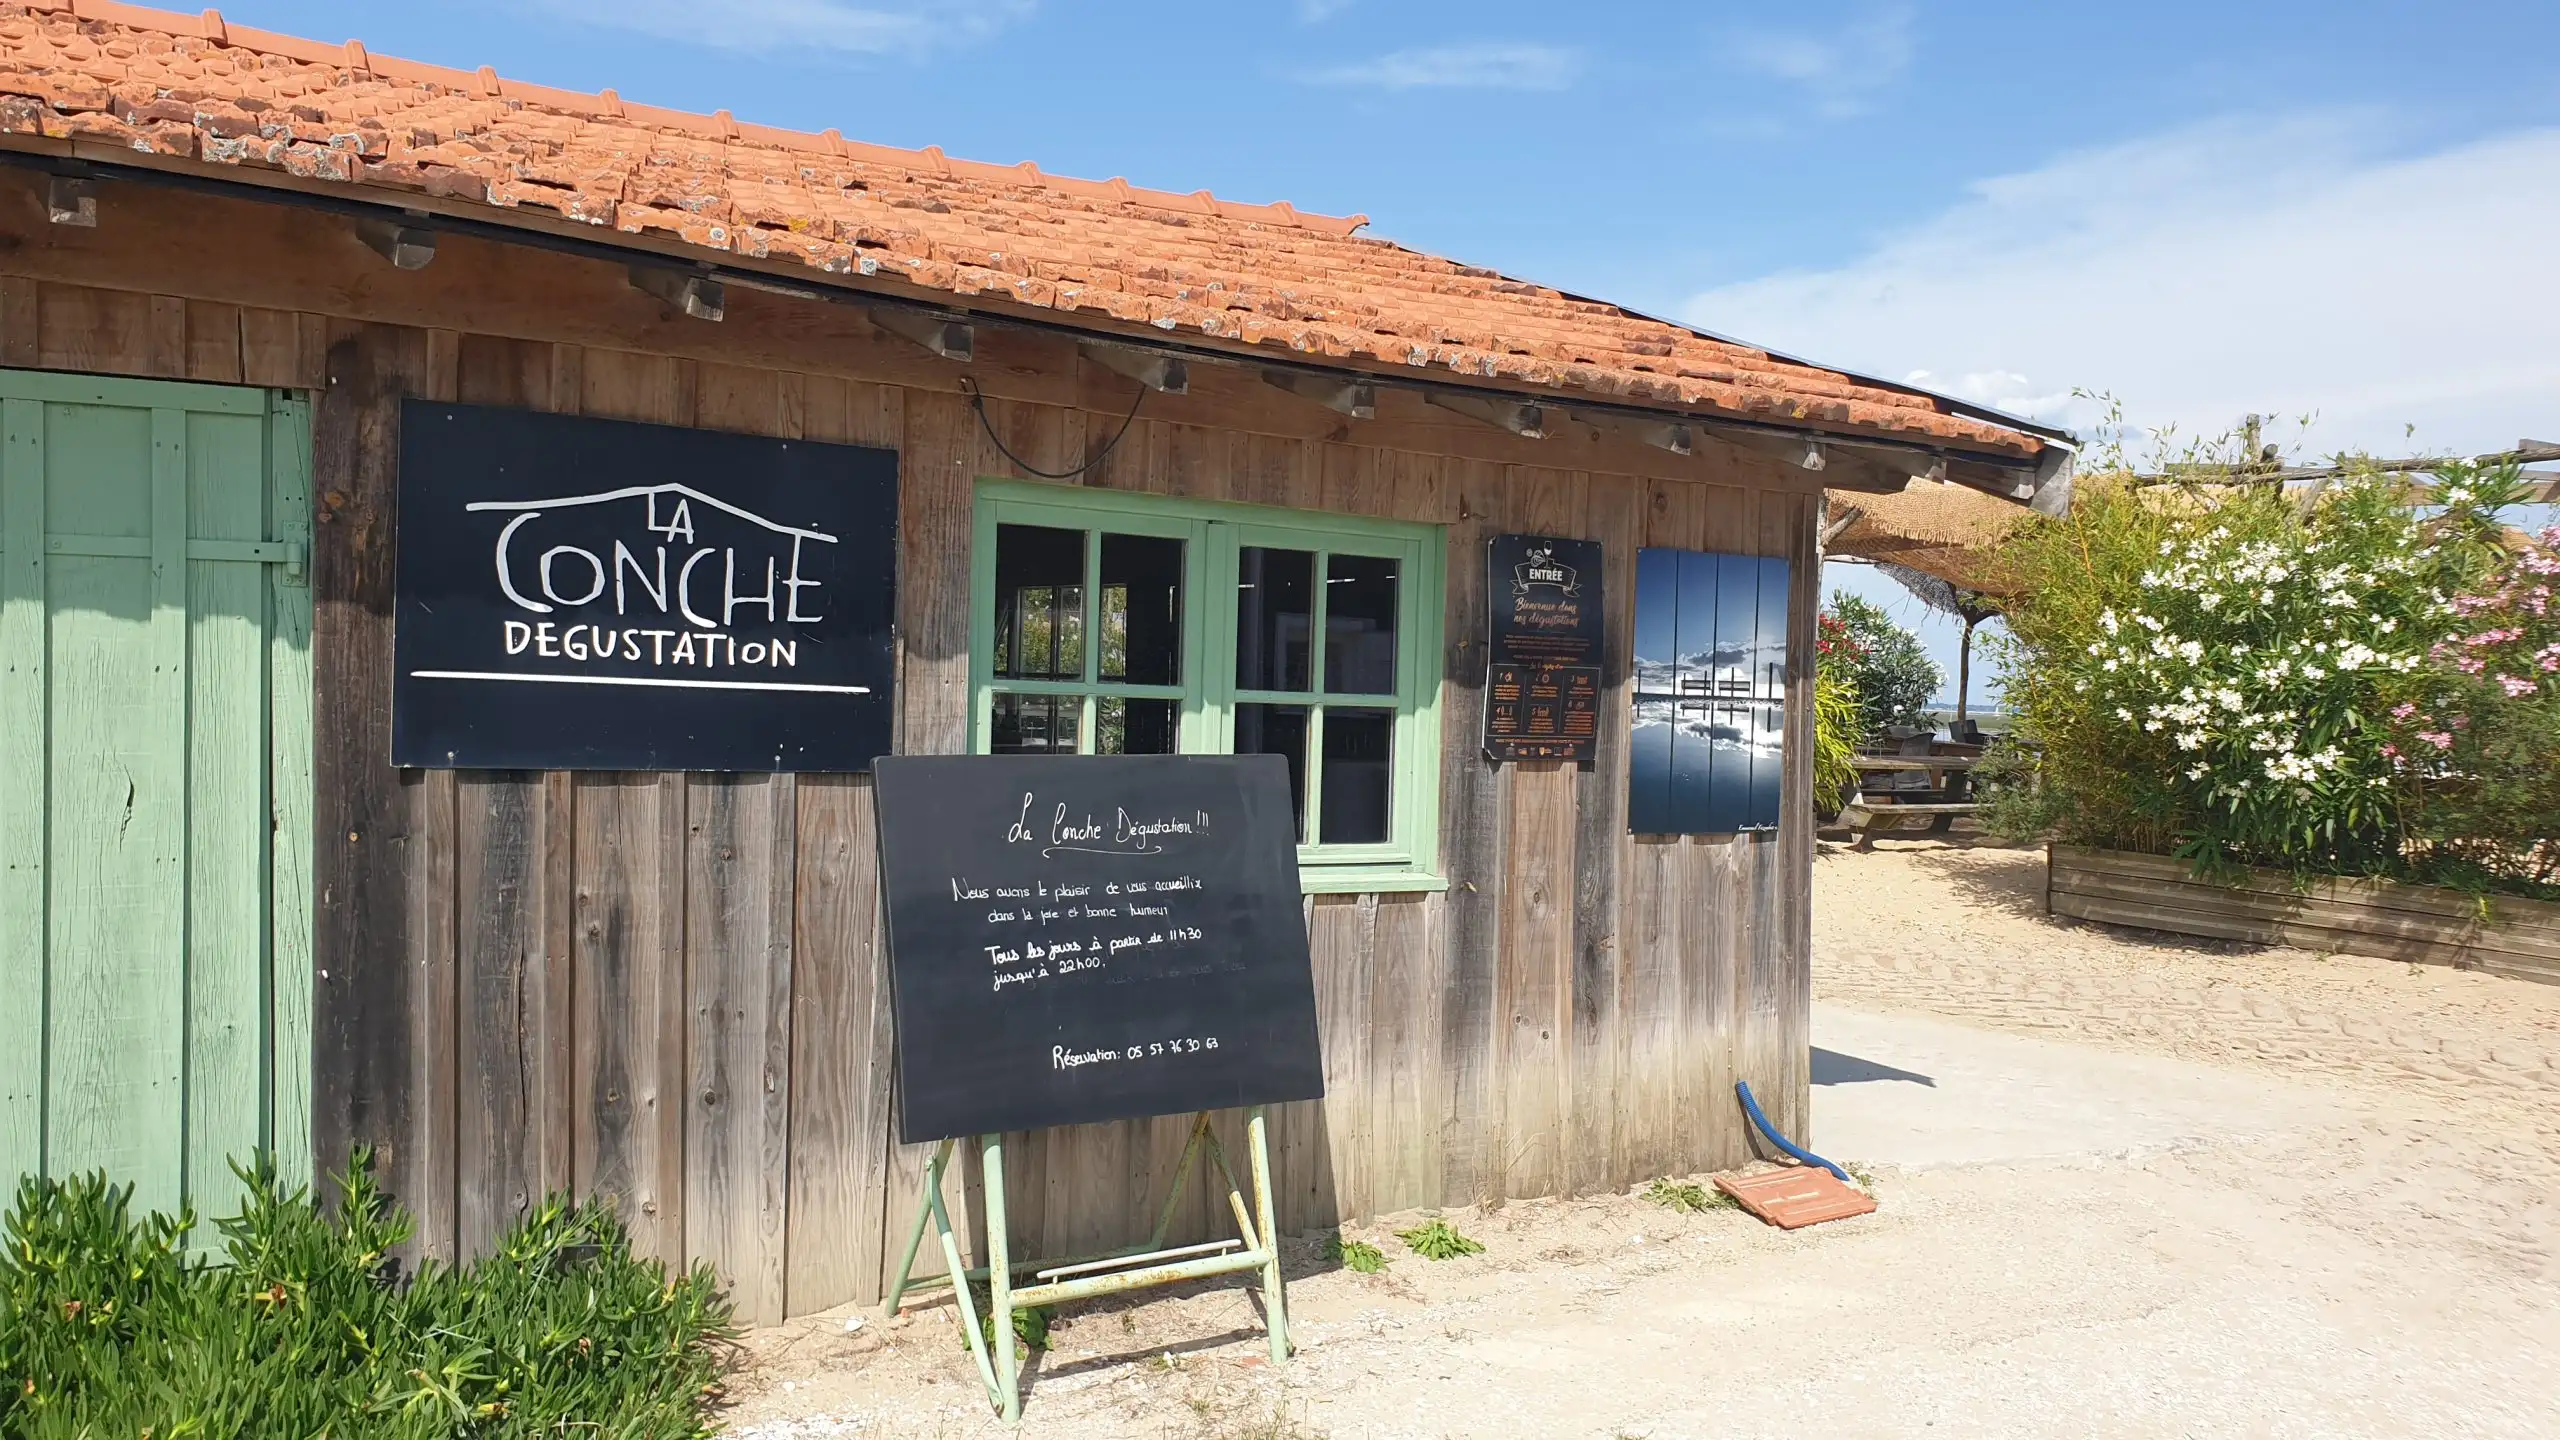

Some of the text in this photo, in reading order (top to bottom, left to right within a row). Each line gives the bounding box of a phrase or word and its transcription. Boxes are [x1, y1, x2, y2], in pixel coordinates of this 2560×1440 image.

[648, 491, 694, 544] LA
[496, 512, 823, 628] CONCHE
[1529, 568, 1563, 582] ENTRÉE
[504, 620, 797, 668] DEGUSTATION
[1008, 792, 1033, 842] La
[1052, 802, 1101, 845] Conche
[952, 877, 990, 901] Nous
[1055, 882, 1091, 902] plaisir
[1106, 882, 1121, 895] de
[1126, 882, 1148, 893] vous
[988, 908, 1015, 922] dans
[1022, 907, 1033, 921] la
[1068, 906, 1079, 918] et
[1085, 903, 1117, 918] bonne
[984, 945, 1020, 965] Tous
[1027, 941, 1046, 959] les
[1048, 940, 1082, 961] jours
[1089, 936, 1103, 951] à
[1110, 935, 1142, 956] partir
[1147, 932, 1164, 944] de
[993, 963, 1050, 991] jusqu'à
[1127, 1046, 1143, 1060] 05
[1149, 1043, 1164, 1056] 57
[1169, 1038, 1182, 1054] 76
[1186, 1038, 1200, 1053] 30
[1206, 1037, 1218, 1050] 63
